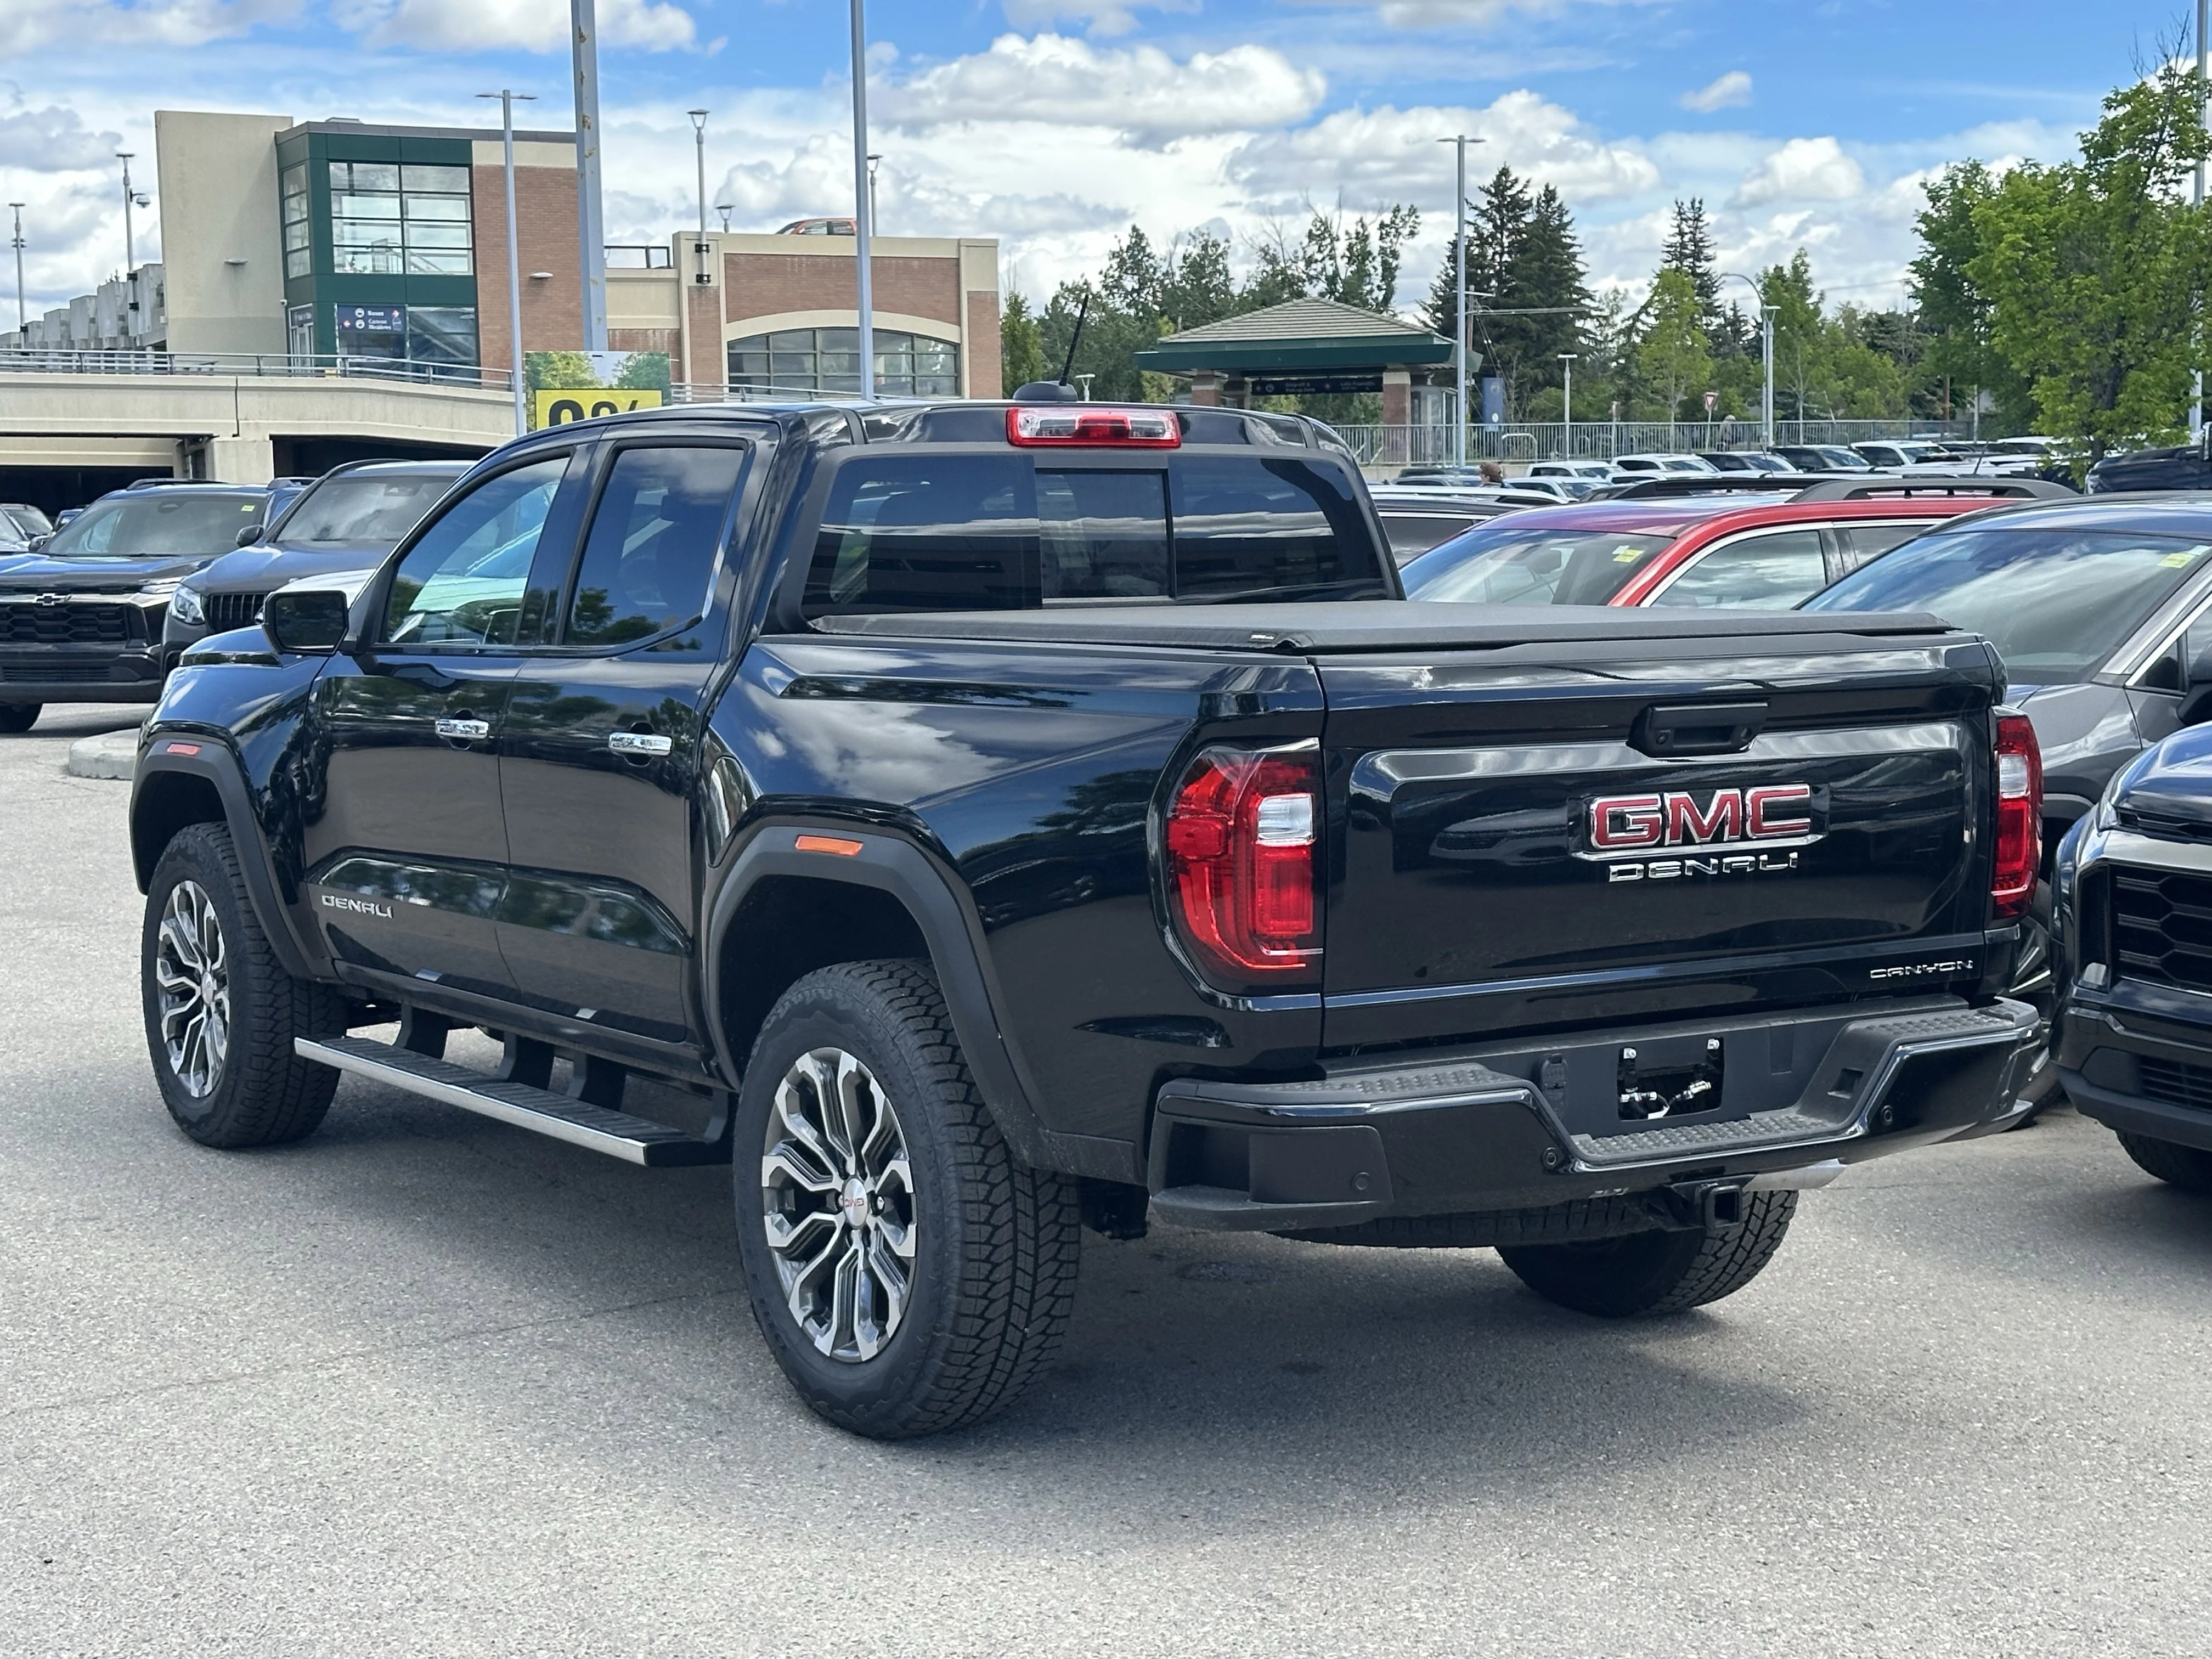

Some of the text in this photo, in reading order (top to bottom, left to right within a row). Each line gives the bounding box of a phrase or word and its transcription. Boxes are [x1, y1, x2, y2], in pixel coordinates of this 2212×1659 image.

[1590, 783, 1811, 850] GMC
[1609, 851, 1799, 883] DENALI
[321, 894, 394, 919] DENALI
[1870, 960, 1973, 979] CANYON
